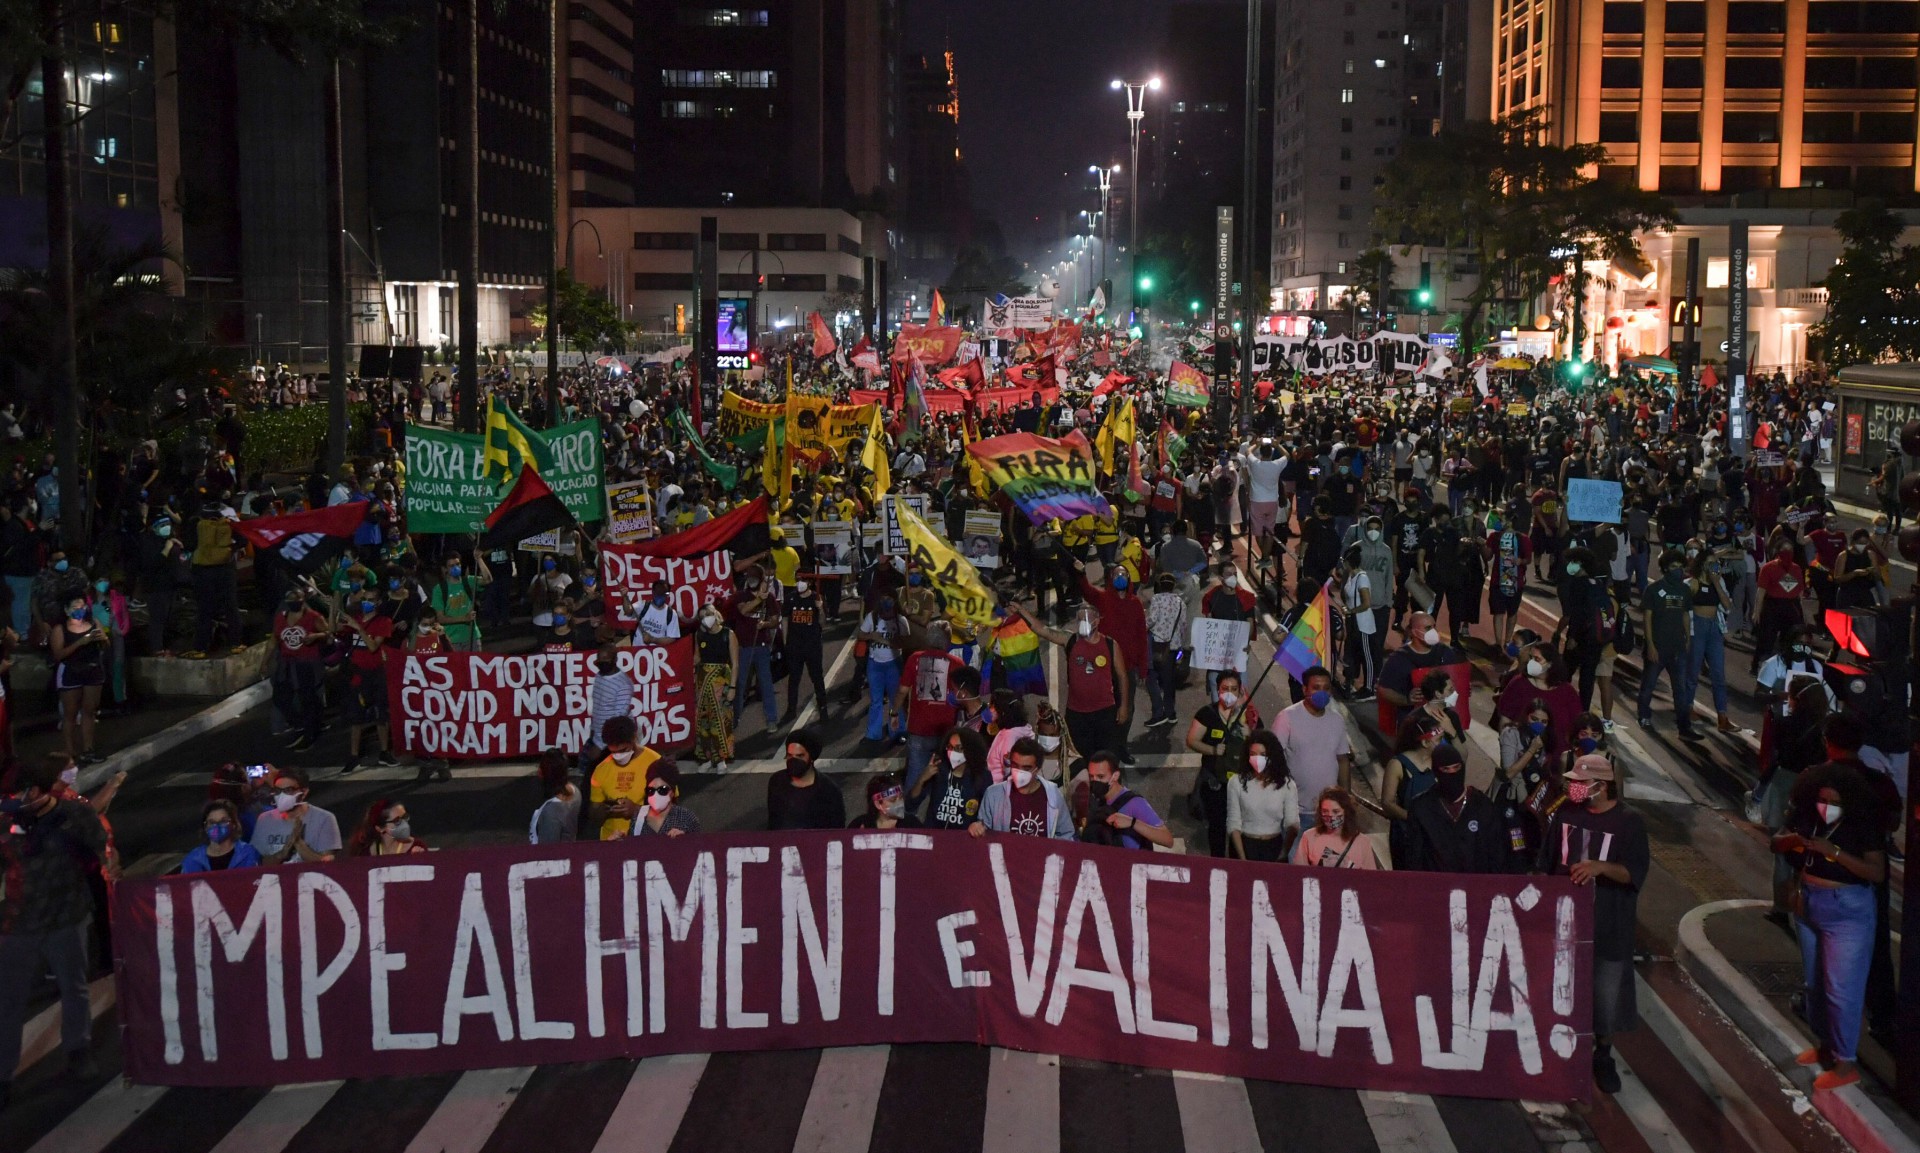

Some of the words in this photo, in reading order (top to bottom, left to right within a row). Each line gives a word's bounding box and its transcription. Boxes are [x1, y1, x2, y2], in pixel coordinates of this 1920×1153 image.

[1218, 232, 1228, 270] Gomide
[1733, 248, 1742, 290] Azevedo
[1218, 271, 1227, 309] Peixoto
[1732, 292, 1741, 322] Rocha
[1731, 346, 1740, 359] Al.
[1732, 324, 1741, 344] Min.
[1875, 405, 1916, 424] FORA
[404, 435, 465, 481] FORA
[407, 497, 465, 514] POPULAR
[409, 480, 453, 497] VACINA
[460, 484, 493, 498] PARA
[602, 548, 732, 589] DESPEJO
[402, 655, 454, 691] AS
[469, 652, 600, 690] MORTES
[614, 646, 676, 686] POR
[401, 685, 498, 723] COVID
[513, 685, 560, 717] NO
[565, 682, 668, 718] BSIL
[404, 718, 507, 755] FORAM
[519, 703, 691, 754] PLANDAS
[154, 831, 935, 1065] IMPEACHMENT
[937, 909, 991, 990] E
[988, 842, 1394, 1066] VACINA
[1414, 883, 1578, 1076] JÁ!
